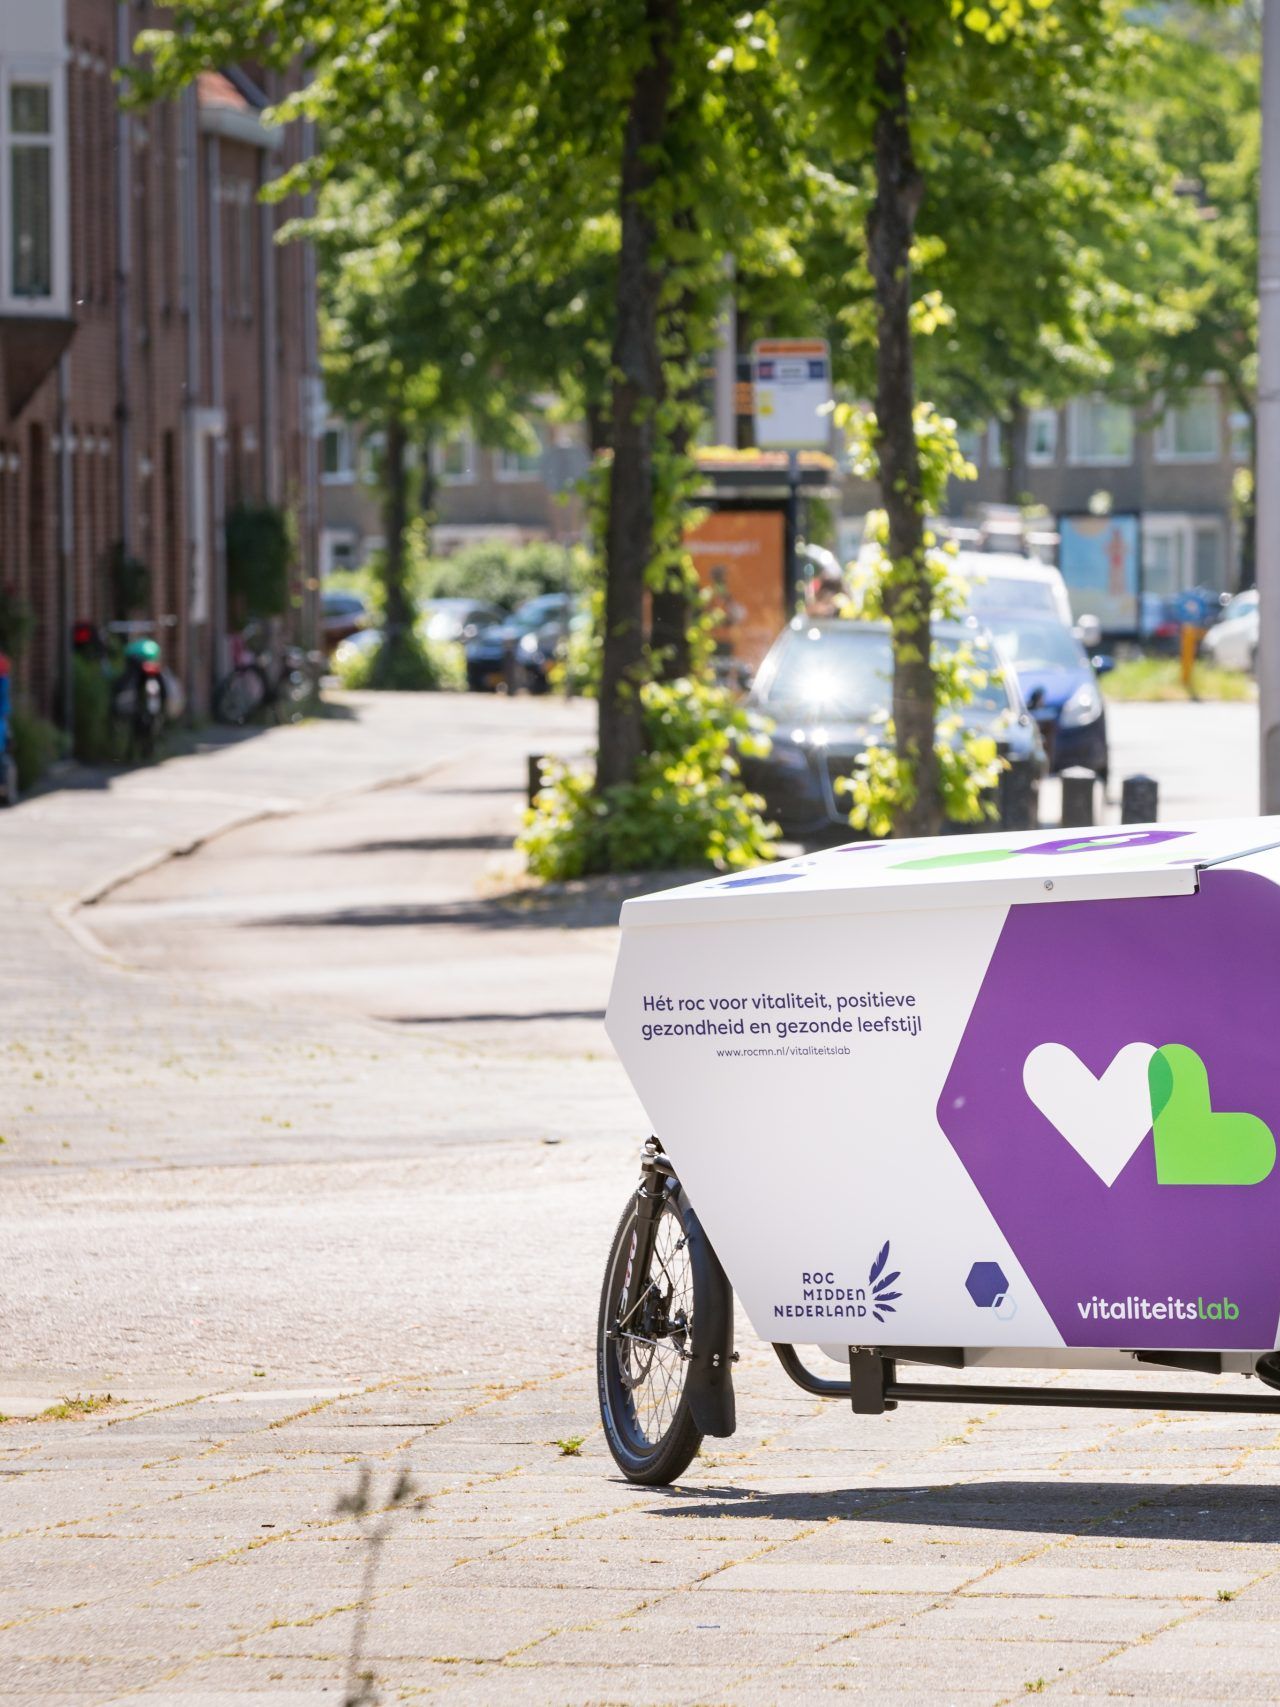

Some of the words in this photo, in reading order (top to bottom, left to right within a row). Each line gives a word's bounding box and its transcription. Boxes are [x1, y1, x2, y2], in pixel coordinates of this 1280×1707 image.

[643, 995, 674, 1011] Hét
[679, 998, 705, 1011] roc
[709, 997, 748, 1010] voor
[752, 992, 832, 1010] vitaliteit,
[837, 991, 916, 1012] positieve
[642, 1019, 744, 1040] gezondheid
[750, 1022, 771, 1034] en
[776, 1017, 853, 1038] gezonde
[858, 1016, 922, 1036] leefstijl
[716, 1045, 851, 1057] www.rocmn.nl/vitaliteitslab
[802, 1272, 835, 1285] ROC
[803, 1288, 866, 1301] MIDDEN
[774, 1305, 867, 1317] NEDERLAND
[1076, 1295, 1240, 1320] vitaliteitslab
